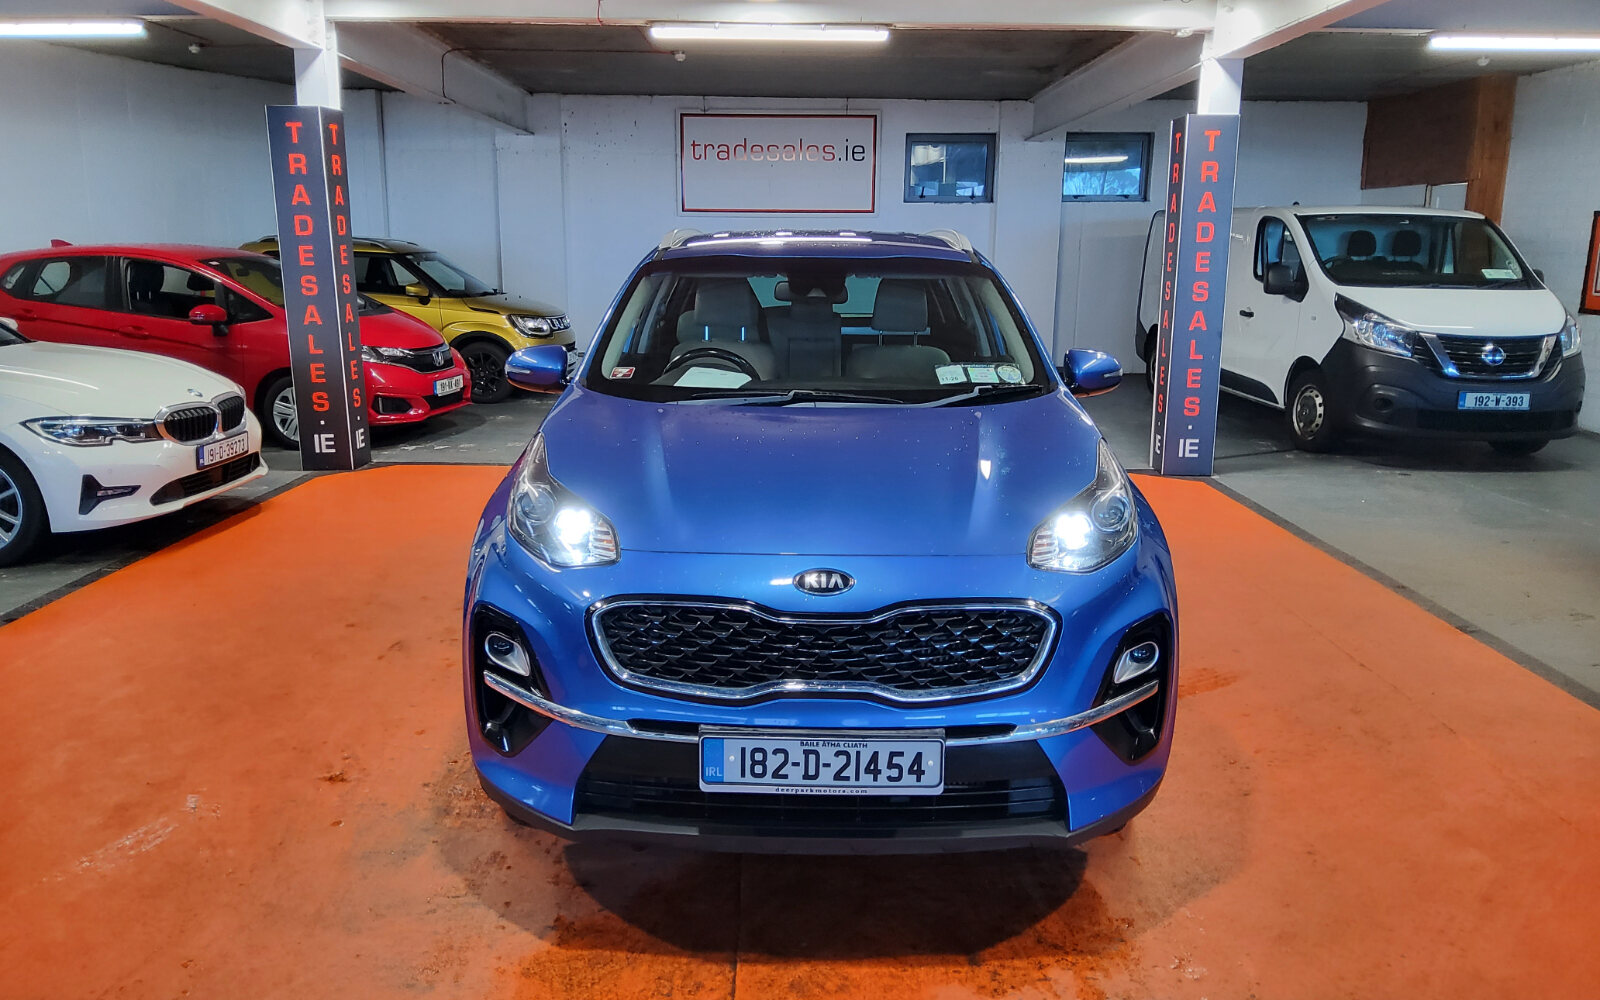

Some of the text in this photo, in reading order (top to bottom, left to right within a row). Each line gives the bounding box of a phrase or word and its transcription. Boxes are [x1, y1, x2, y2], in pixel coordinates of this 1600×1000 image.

[690, 137, 866, 162] tradesales.ie
[1474, 395, 1524, 407] 192-W-393
[207, 438, 245, 464] 191-D-39273
[804, 573, 844, 589] KIA
[705, 766, 722, 777] IRL
[740, 746, 926, 783] 182-D-21454
